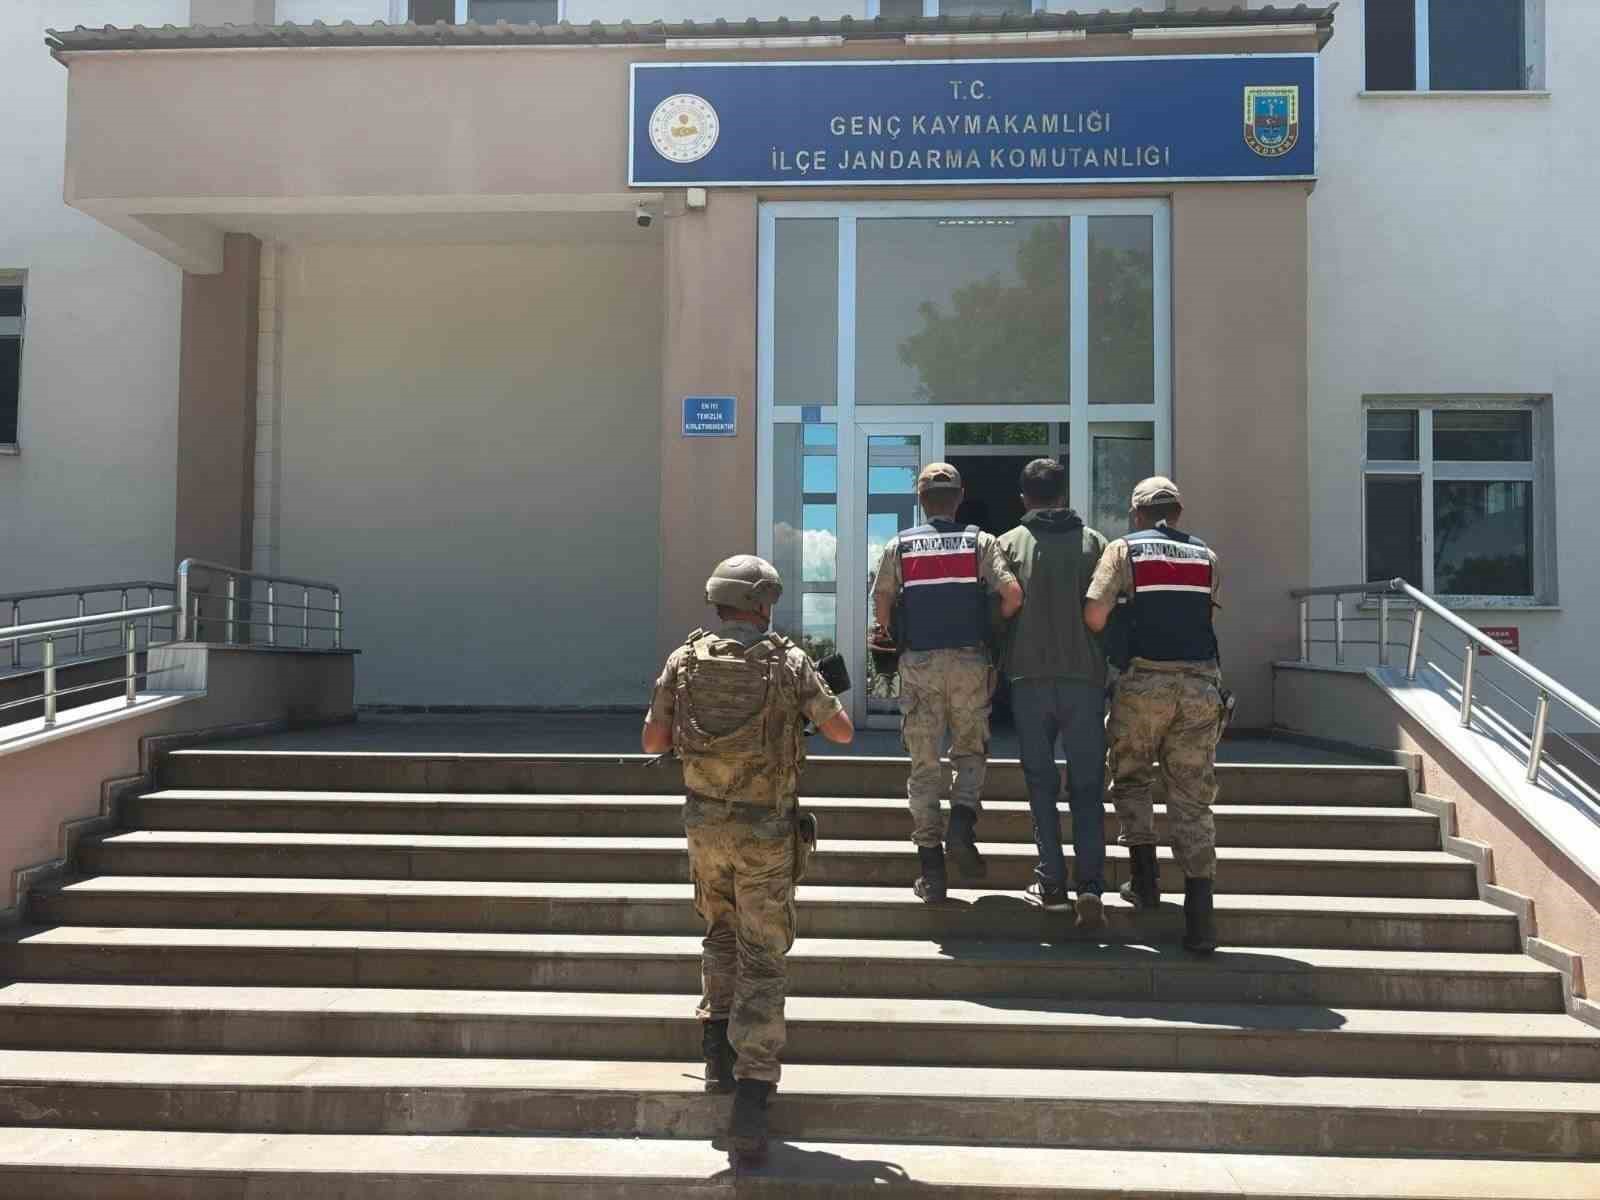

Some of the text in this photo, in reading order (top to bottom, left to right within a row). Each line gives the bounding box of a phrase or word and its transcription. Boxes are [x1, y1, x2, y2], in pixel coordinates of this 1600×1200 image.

[950, 80, 992, 100] T.C.
[830, 110, 1110, 139] GENÇ KAYMAKAMLIĞI
[771, 145, 1169, 175] İLÇE JANDARMA KOMUTANLIĞI
[912, 537, 968, 552] JANDARMA
